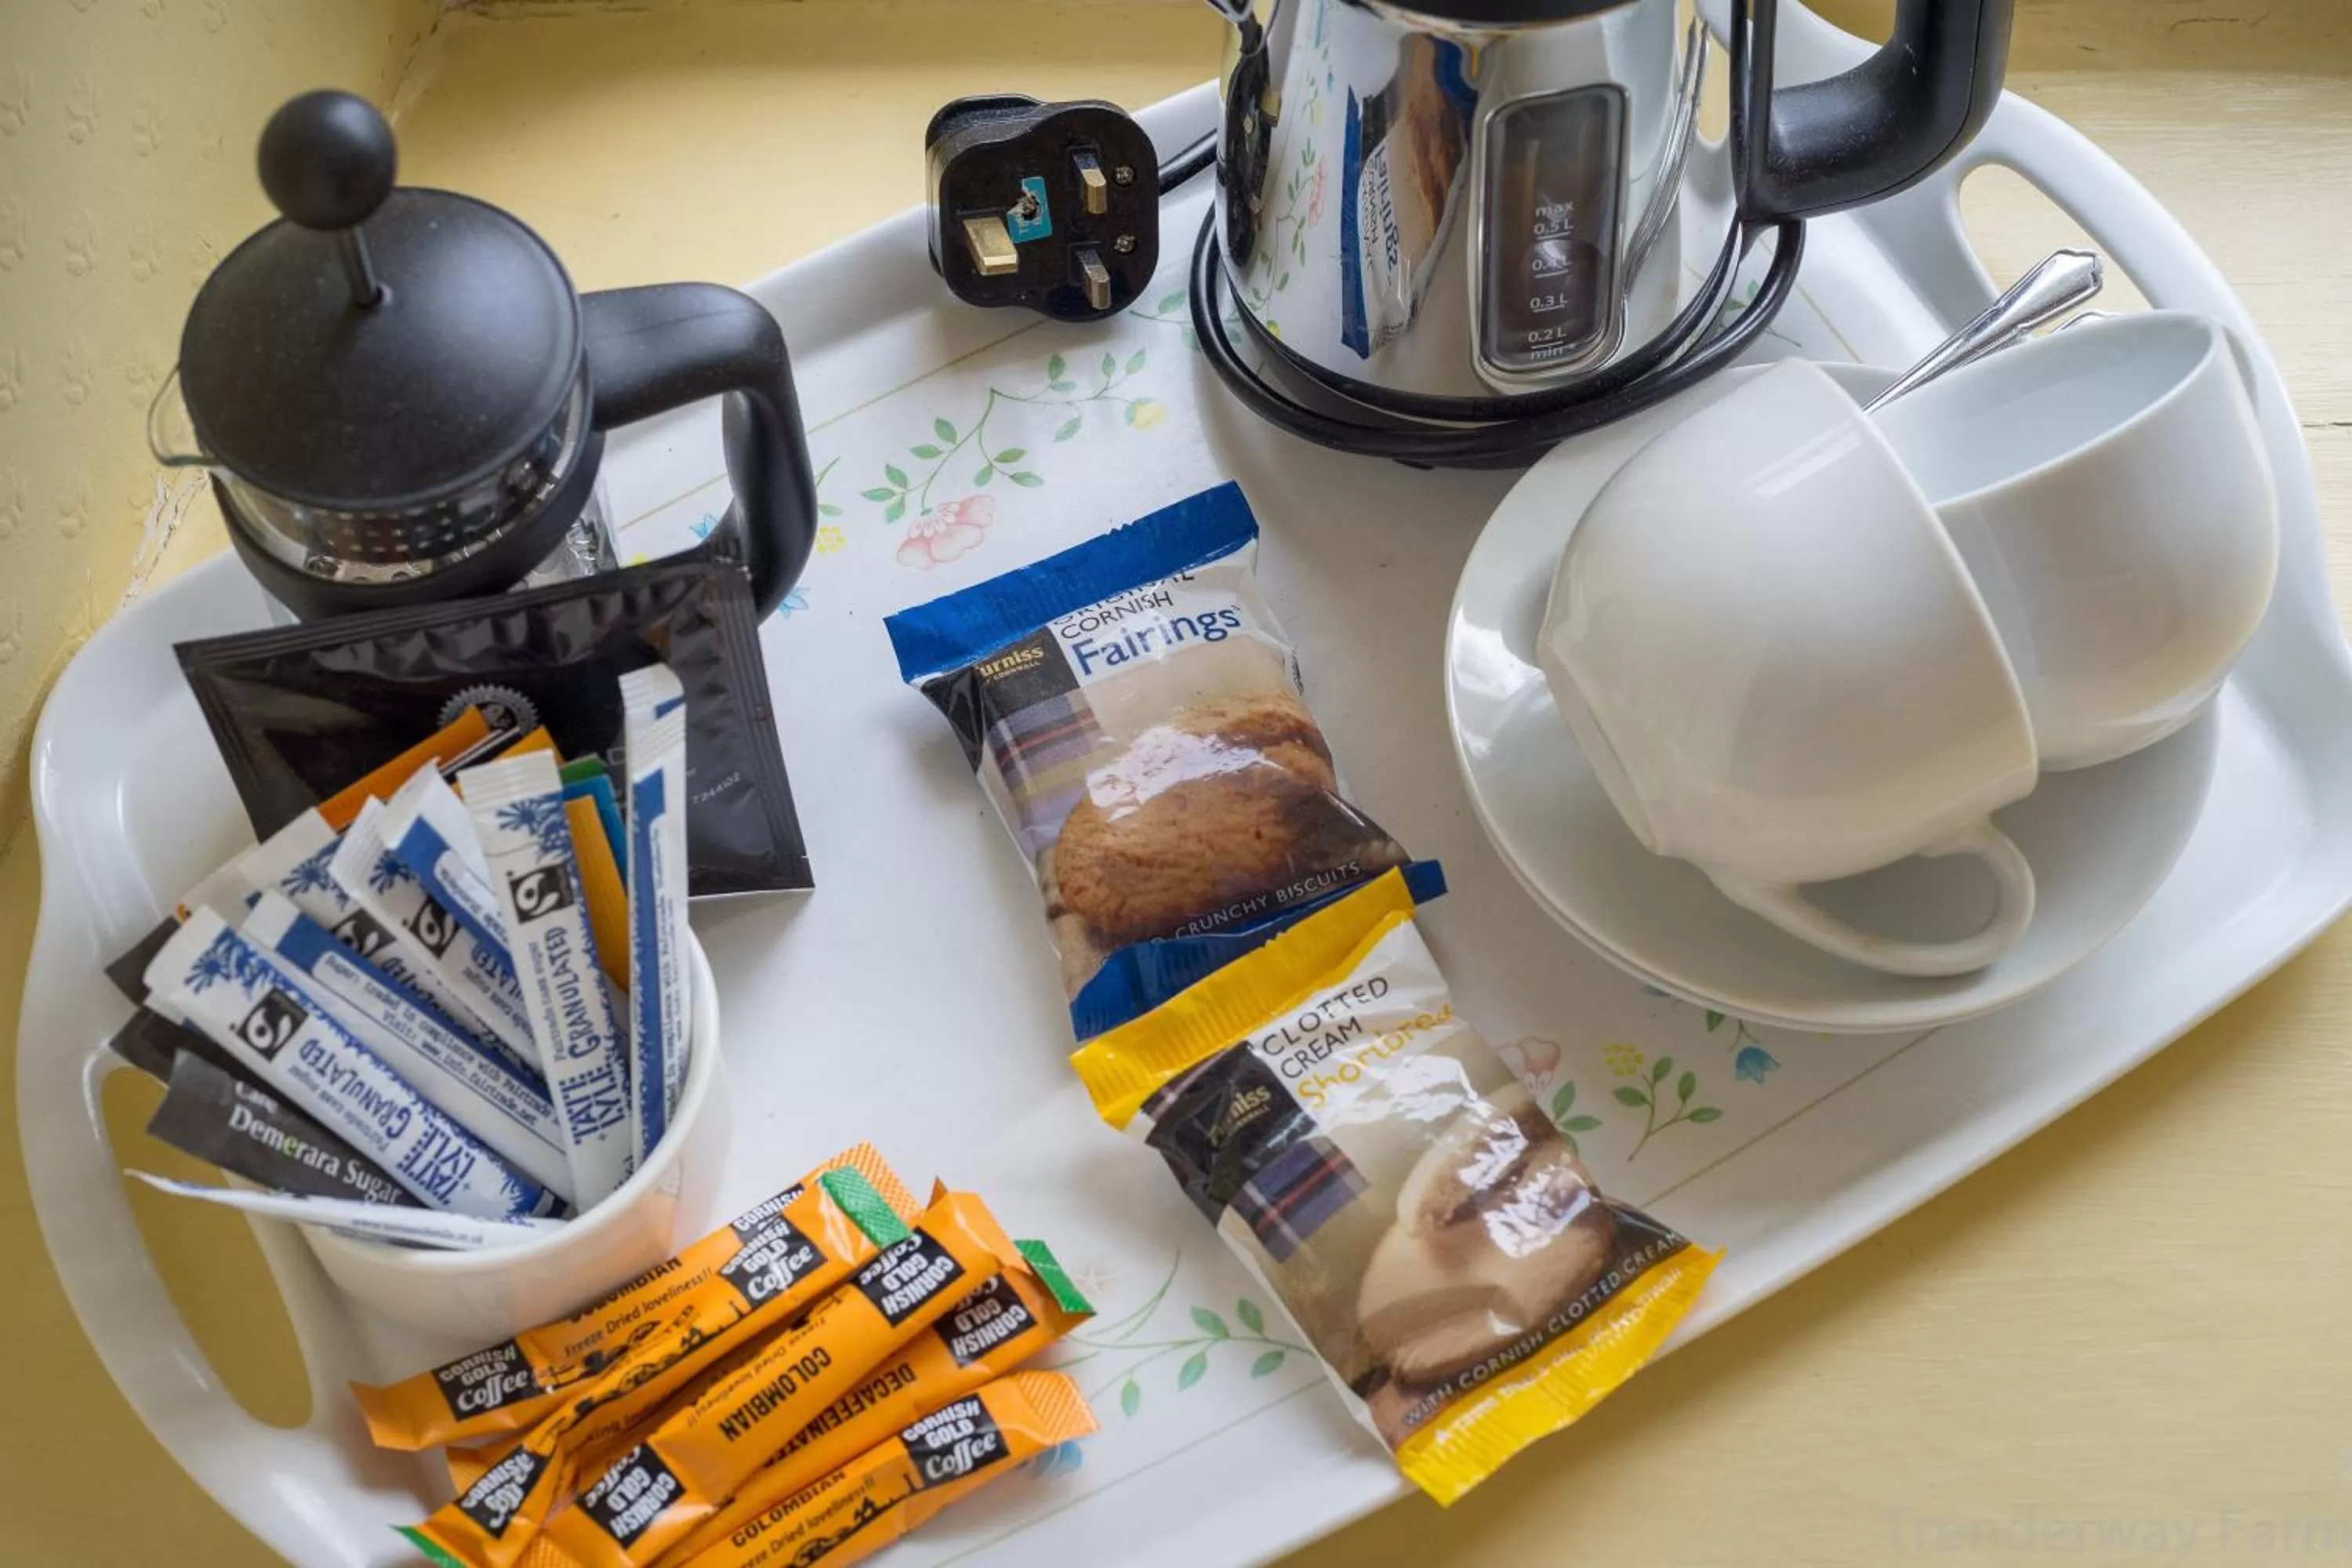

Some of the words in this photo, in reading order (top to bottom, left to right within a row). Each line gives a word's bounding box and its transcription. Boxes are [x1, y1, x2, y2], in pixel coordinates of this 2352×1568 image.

[1534, 200, 1575, 217] max
[1534, 220, 1559, 235] 0.5
[1530, 296, 1555, 308] 0.3
[1529, 328, 1554, 343] 0.2
[1530, 346, 1565, 361] min
[1061, 590, 1174, 640] CORNISH
[979, 645, 1044, 677] urniss
[1071, 609, 1241, 676] Fairings
[1175, 895, 1268, 942] CRUNCHY
[1276, 862, 1361, 902] BISCUITS
[545, 926, 601, 1059] GRANULATED
[1263, 977, 1388, 1057] CLOTTED
[478, 1058, 502, 1083] with
[1281, 1016, 1363, 1080] CREAM
[299, 1037, 412, 1140] GRANULATED
[558, 1073, 600, 1145] TATE
[589, 1062, 626, 1130] LYLE
[228, 1103, 341, 1178] Demerara
[343, 1159, 403, 1204] Sugar
[417, 1117, 476, 1179] LYLE
[396, 1149, 461, 1206] TATE
[742, 1238, 788, 1274] GOLD
[747, 1244, 813, 1300] Coffee
[881, 1253, 929, 1292] GOLD
[881, 1255, 954, 1317] CORNISH
[605, 1305, 641, 1334] Dried
[952, 1304, 1028, 1357] CORNISH
[954, 1297, 1002, 1333] GOLD
[1404, 1383, 1454, 1427] WITH
[1458, 1331, 1544, 1389] CORNISH
[1548, 1272, 1621, 1334] CLOTTED
[1622, 1232, 1686, 1275] CREAM
[439, 1345, 517, 1382] CORNISH
[461, 1361, 508, 1387] GOLD
[456, 1370, 529, 1412] Coffee
[717, 1345, 832, 1443] COLOMBIAN
[902, 1398, 981, 1442] CORNISH
[925, 1418, 975, 1450] GOLD
[925, 1432, 997, 1480] Coffee
[607, 1465, 651, 1512] GOLD
[609, 1471, 677, 1539] CORNISH
[731, 1470, 847, 1548] COLOMBIAN
[770, 1522, 807, 1554] Dried
